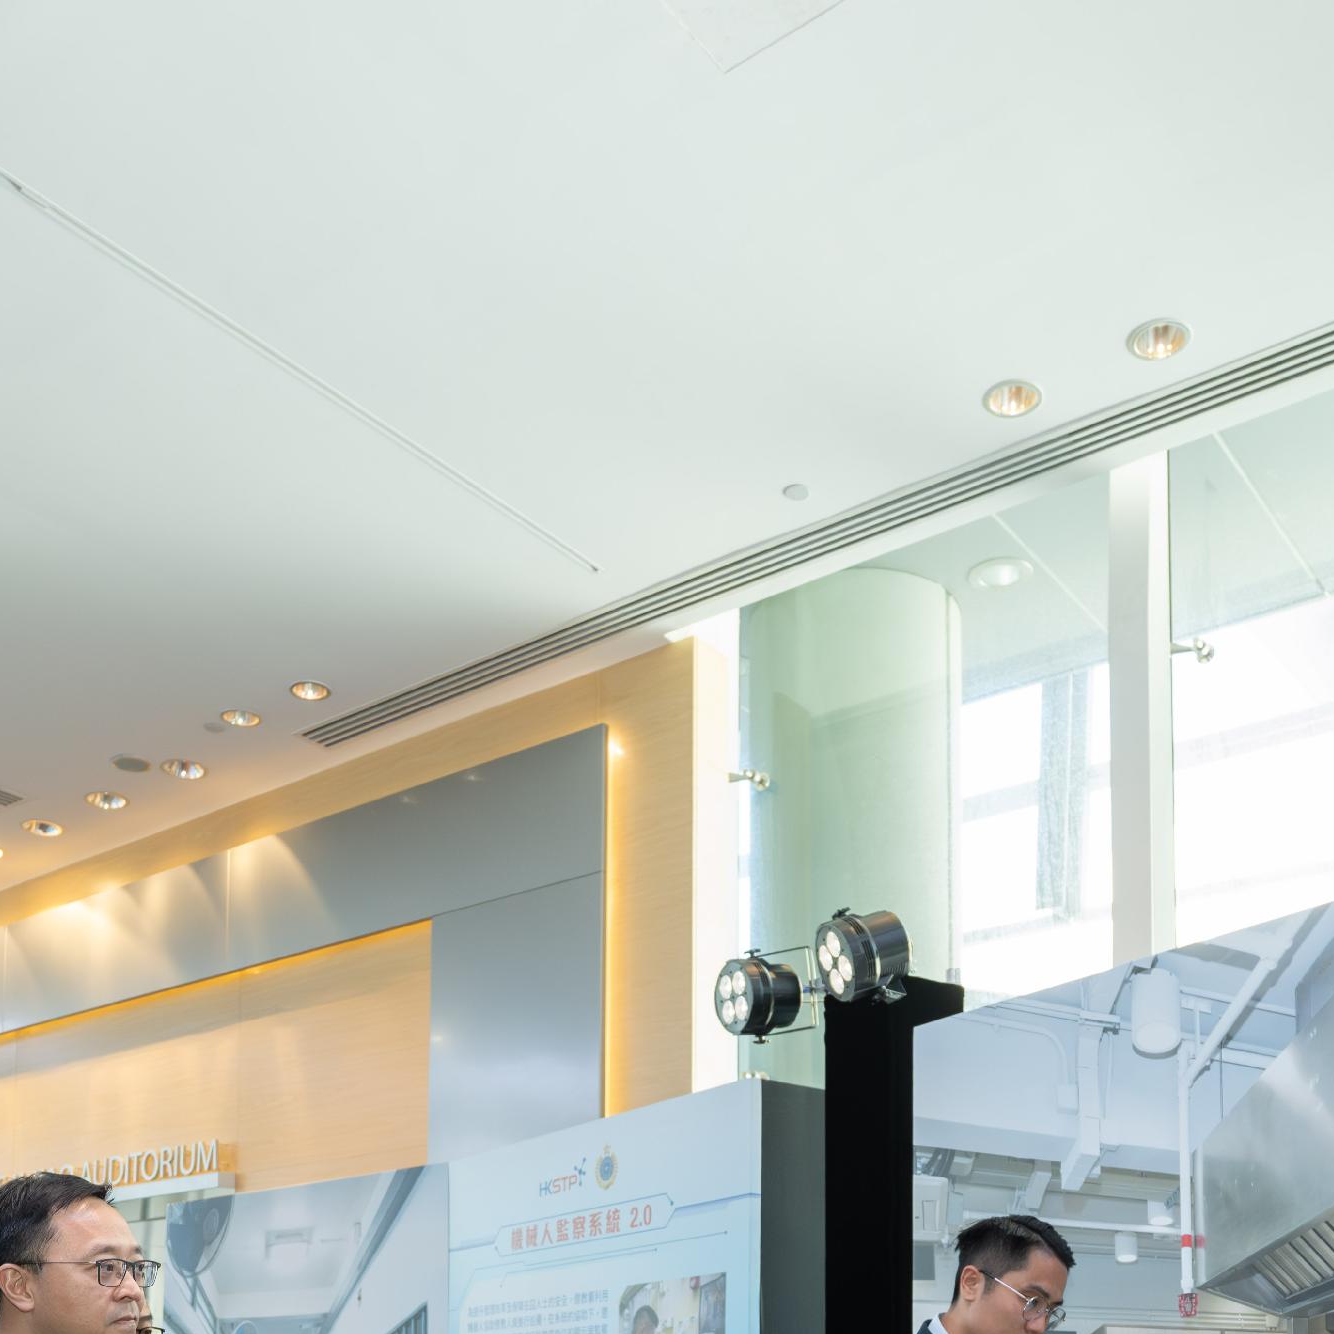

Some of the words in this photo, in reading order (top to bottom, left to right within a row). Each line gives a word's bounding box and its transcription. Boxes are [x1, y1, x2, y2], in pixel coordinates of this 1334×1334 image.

[81, 1139, 218, 1187] AUDITORIUM
[539, 1175, 578, 1198] HKSTP
[629, 1204, 653, 1229] 2.0
